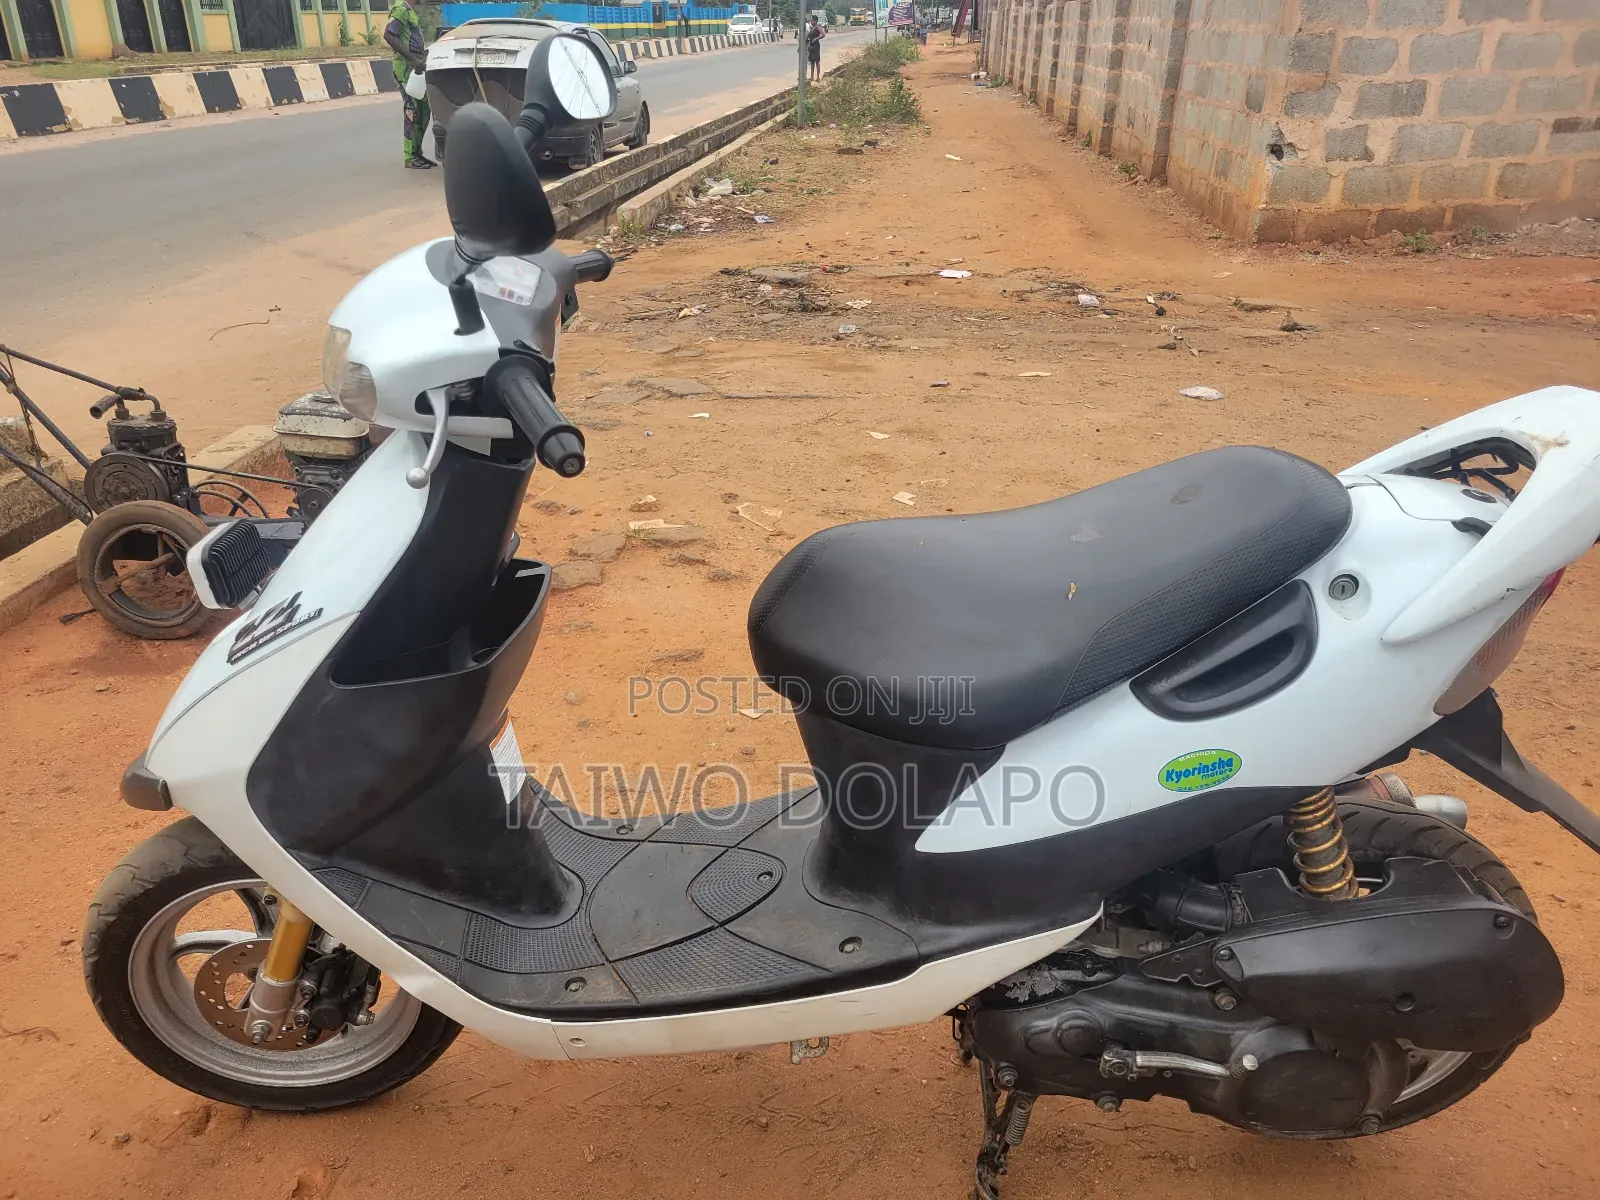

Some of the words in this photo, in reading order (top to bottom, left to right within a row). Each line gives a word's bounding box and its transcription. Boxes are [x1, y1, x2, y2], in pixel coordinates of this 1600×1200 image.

[1178, 750, 1217, 762] MACHIDA
[1165, 757, 1234, 784] Kyorinsha
[1201, 768, 1233, 780] motors
